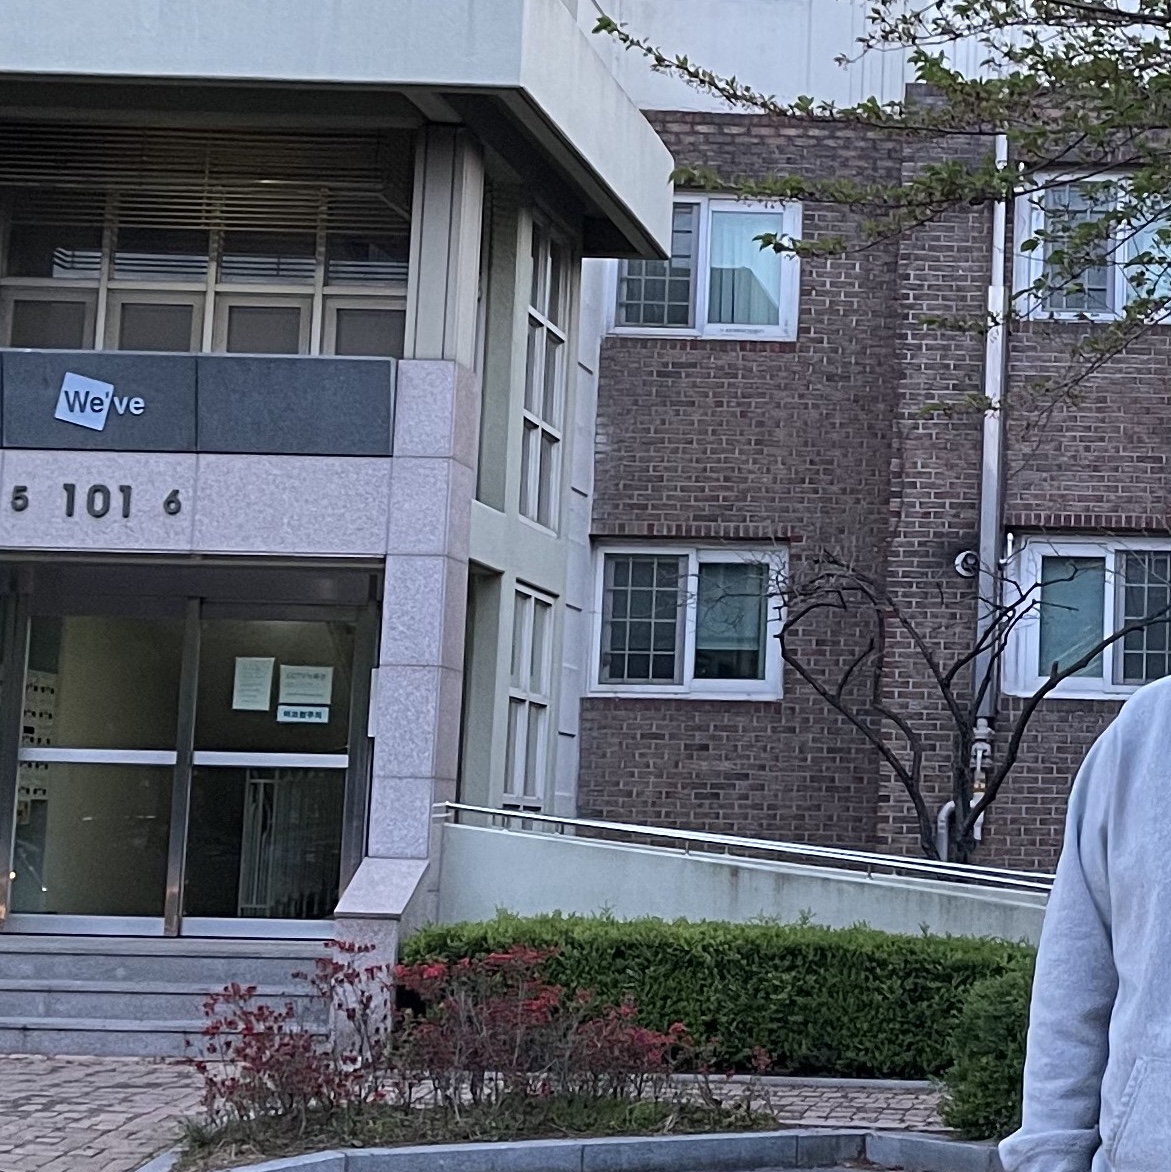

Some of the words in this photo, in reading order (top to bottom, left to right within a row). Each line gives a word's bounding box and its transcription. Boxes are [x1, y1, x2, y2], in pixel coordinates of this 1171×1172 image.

[64, 390, 145, 415] We've
[11, 485, 29, 512] 5
[63, 483, 132, 518] 101
[163, 489, 181, 515] 6
